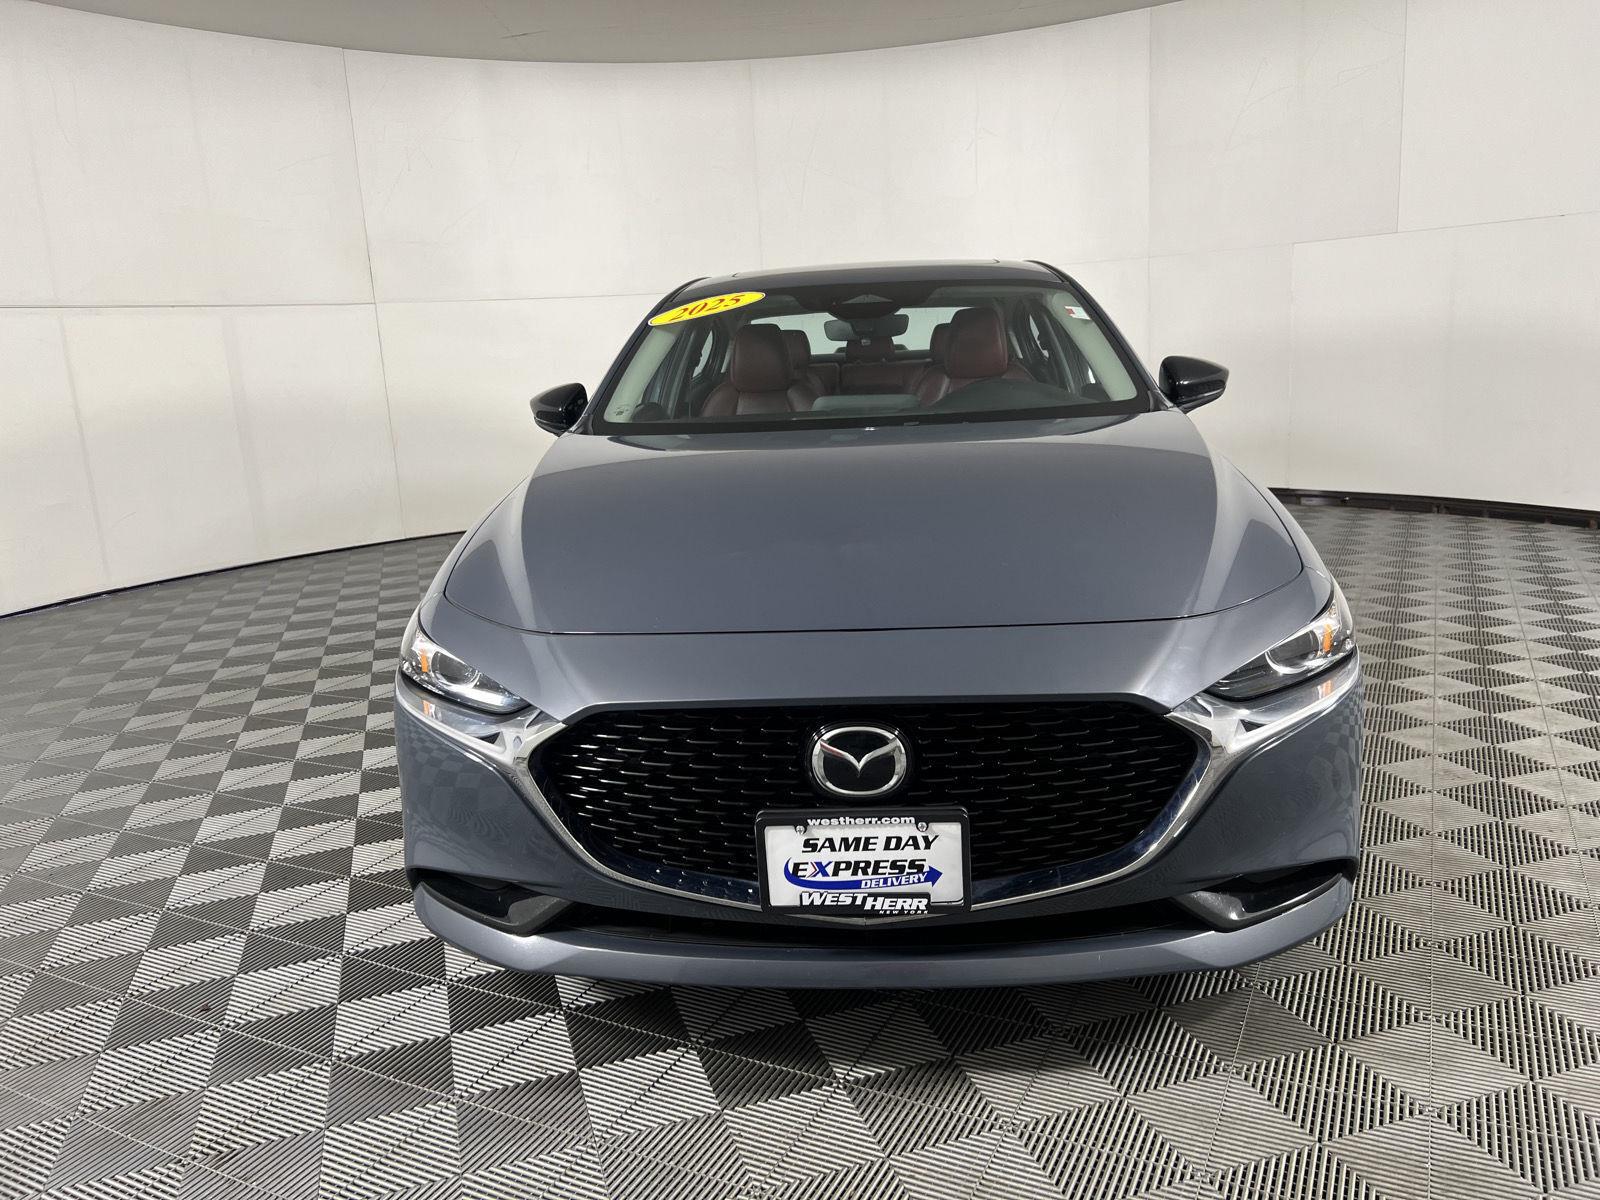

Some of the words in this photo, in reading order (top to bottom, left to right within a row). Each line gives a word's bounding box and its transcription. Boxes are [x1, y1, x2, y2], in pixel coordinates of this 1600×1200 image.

[669, 295, 745, 321] 2025
[807, 816, 915, 825] westherr.com
[802, 836, 878, 853] SAME
[883, 835, 939, 851] DAY
[791, 859, 926, 878] EXPRESS
[861, 872, 927, 889] DELIVERY
